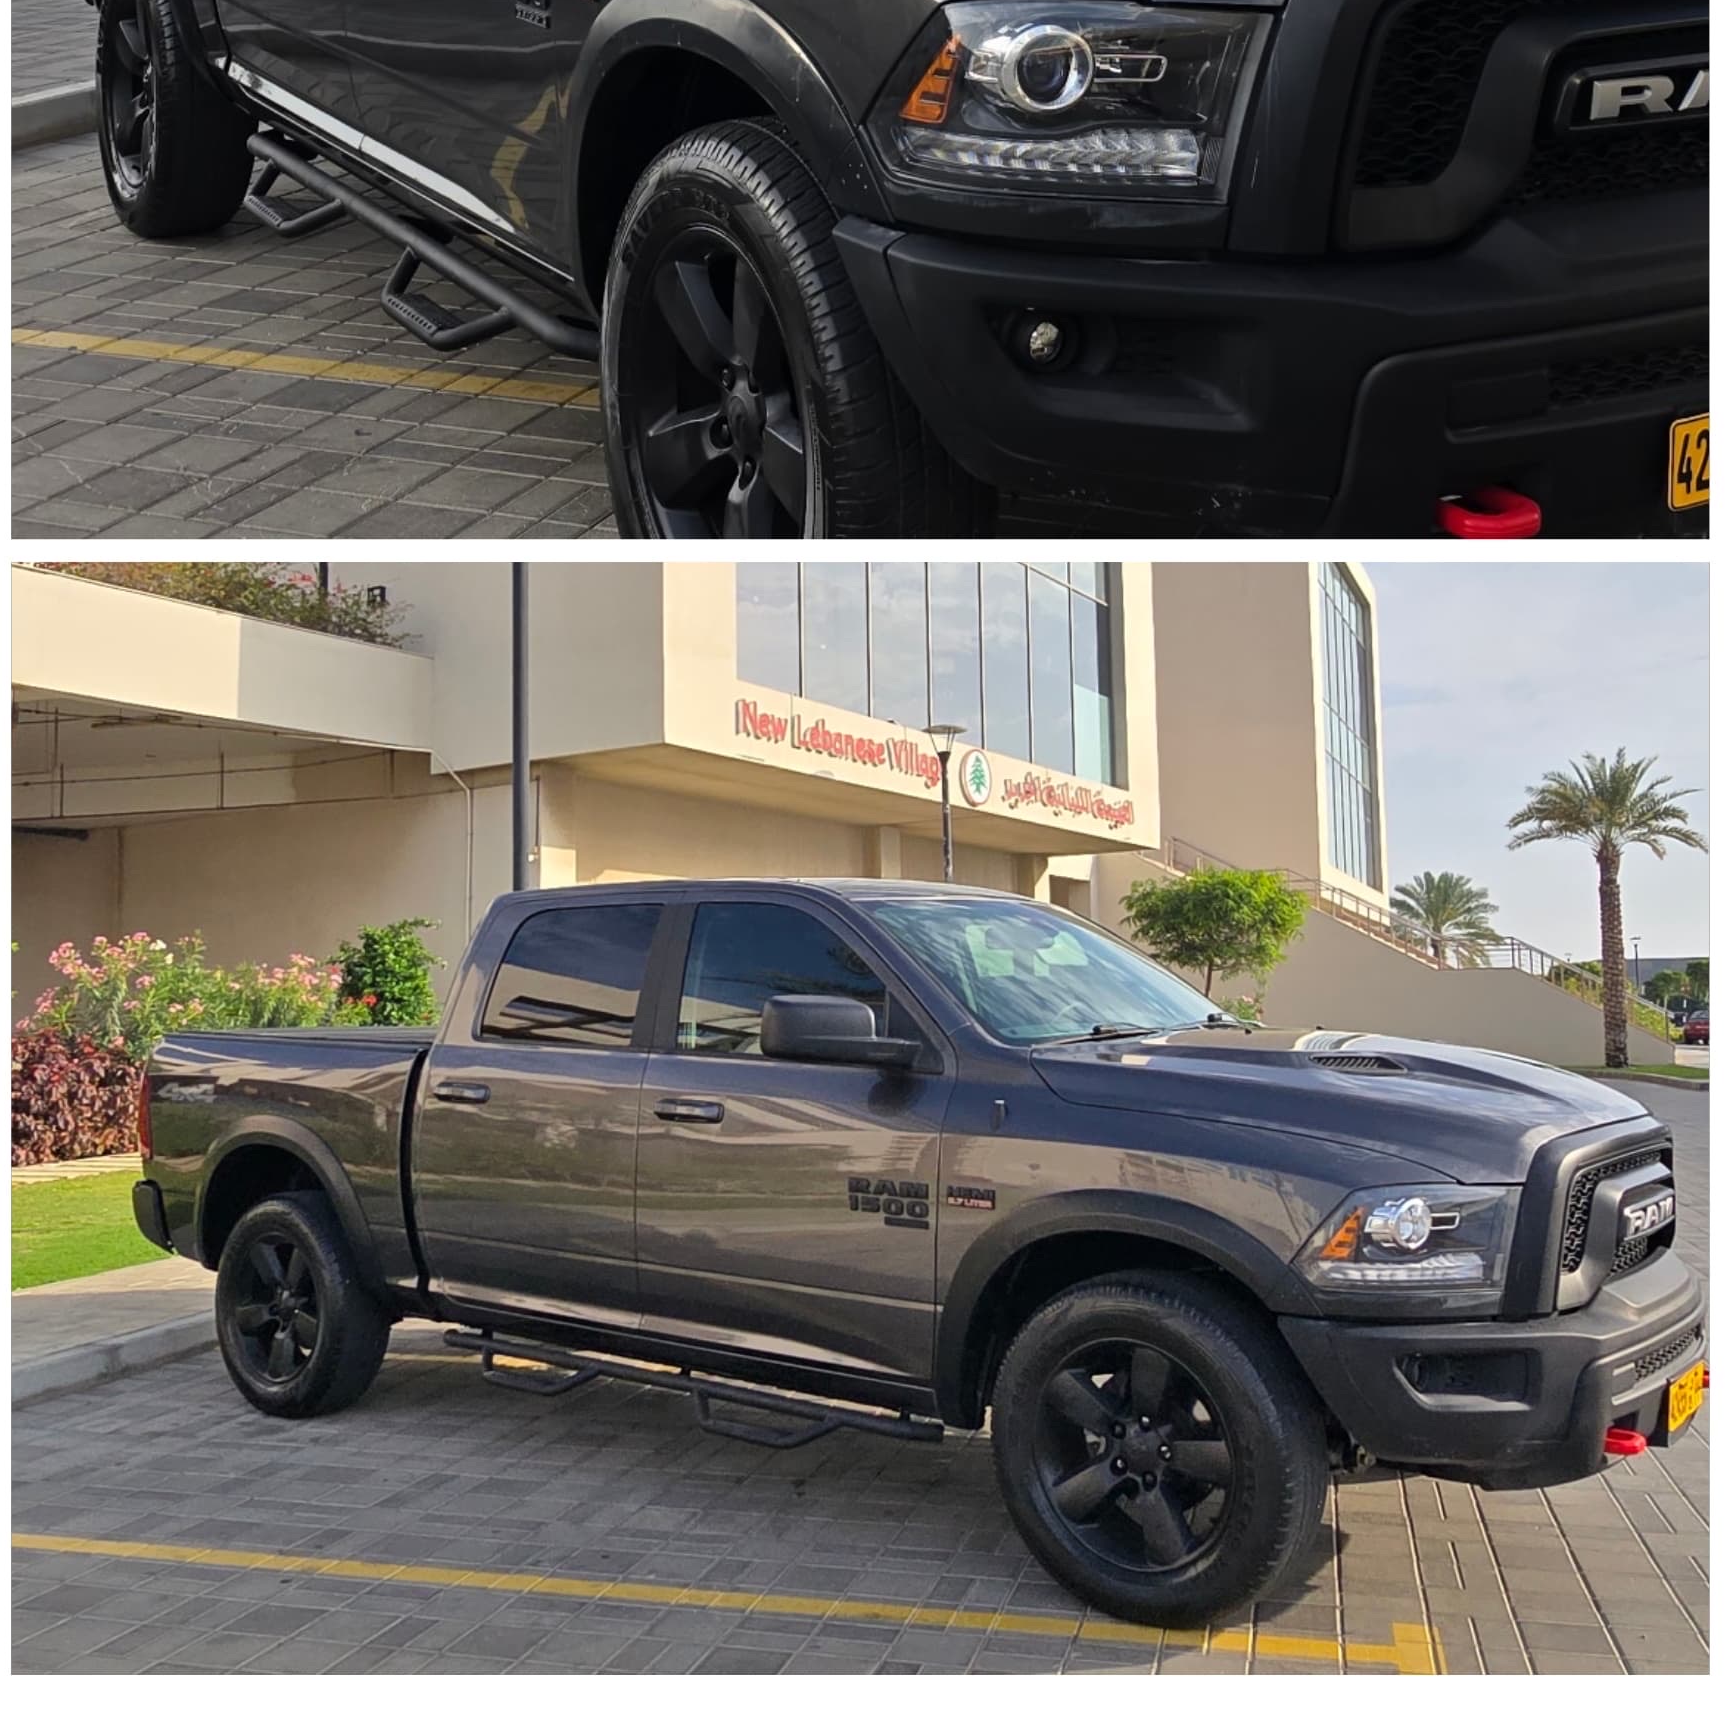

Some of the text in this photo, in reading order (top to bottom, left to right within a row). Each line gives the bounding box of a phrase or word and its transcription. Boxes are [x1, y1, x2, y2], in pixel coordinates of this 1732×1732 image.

[737, 699, 941, 788] New Lebanese Villag
[848, 1176, 929, 1200] RAM
[947, 1185, 996, 1200] HEMI
[849, 1195, 929, 1218] 1500
[1628, 1197, 1674, 1236] RAM
